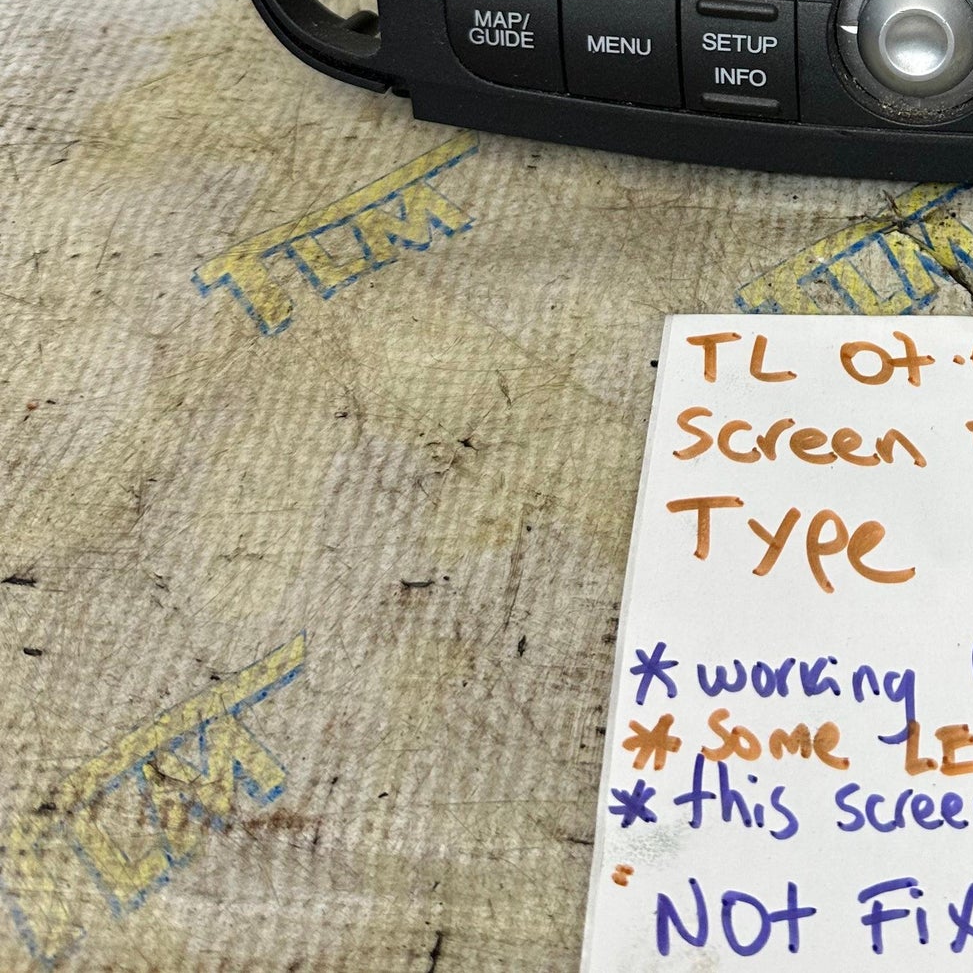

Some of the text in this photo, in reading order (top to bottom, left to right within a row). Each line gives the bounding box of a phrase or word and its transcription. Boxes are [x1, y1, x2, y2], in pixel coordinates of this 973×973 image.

[468, 28, 536, 49] GUIDE
[473, 9, 531, 30] MAP/
[586, 35, 653, 56] MENU
[701, 32, 779, 55] SETUP
[714, 67, 768, 88] INFO
[191, 128, 480, 337] TLM
[686, 330, 798, 387] TL
[665, 496, 917, 594] Type
[696, 655, 916, 746] working
[674, 752, 799, 840] this
